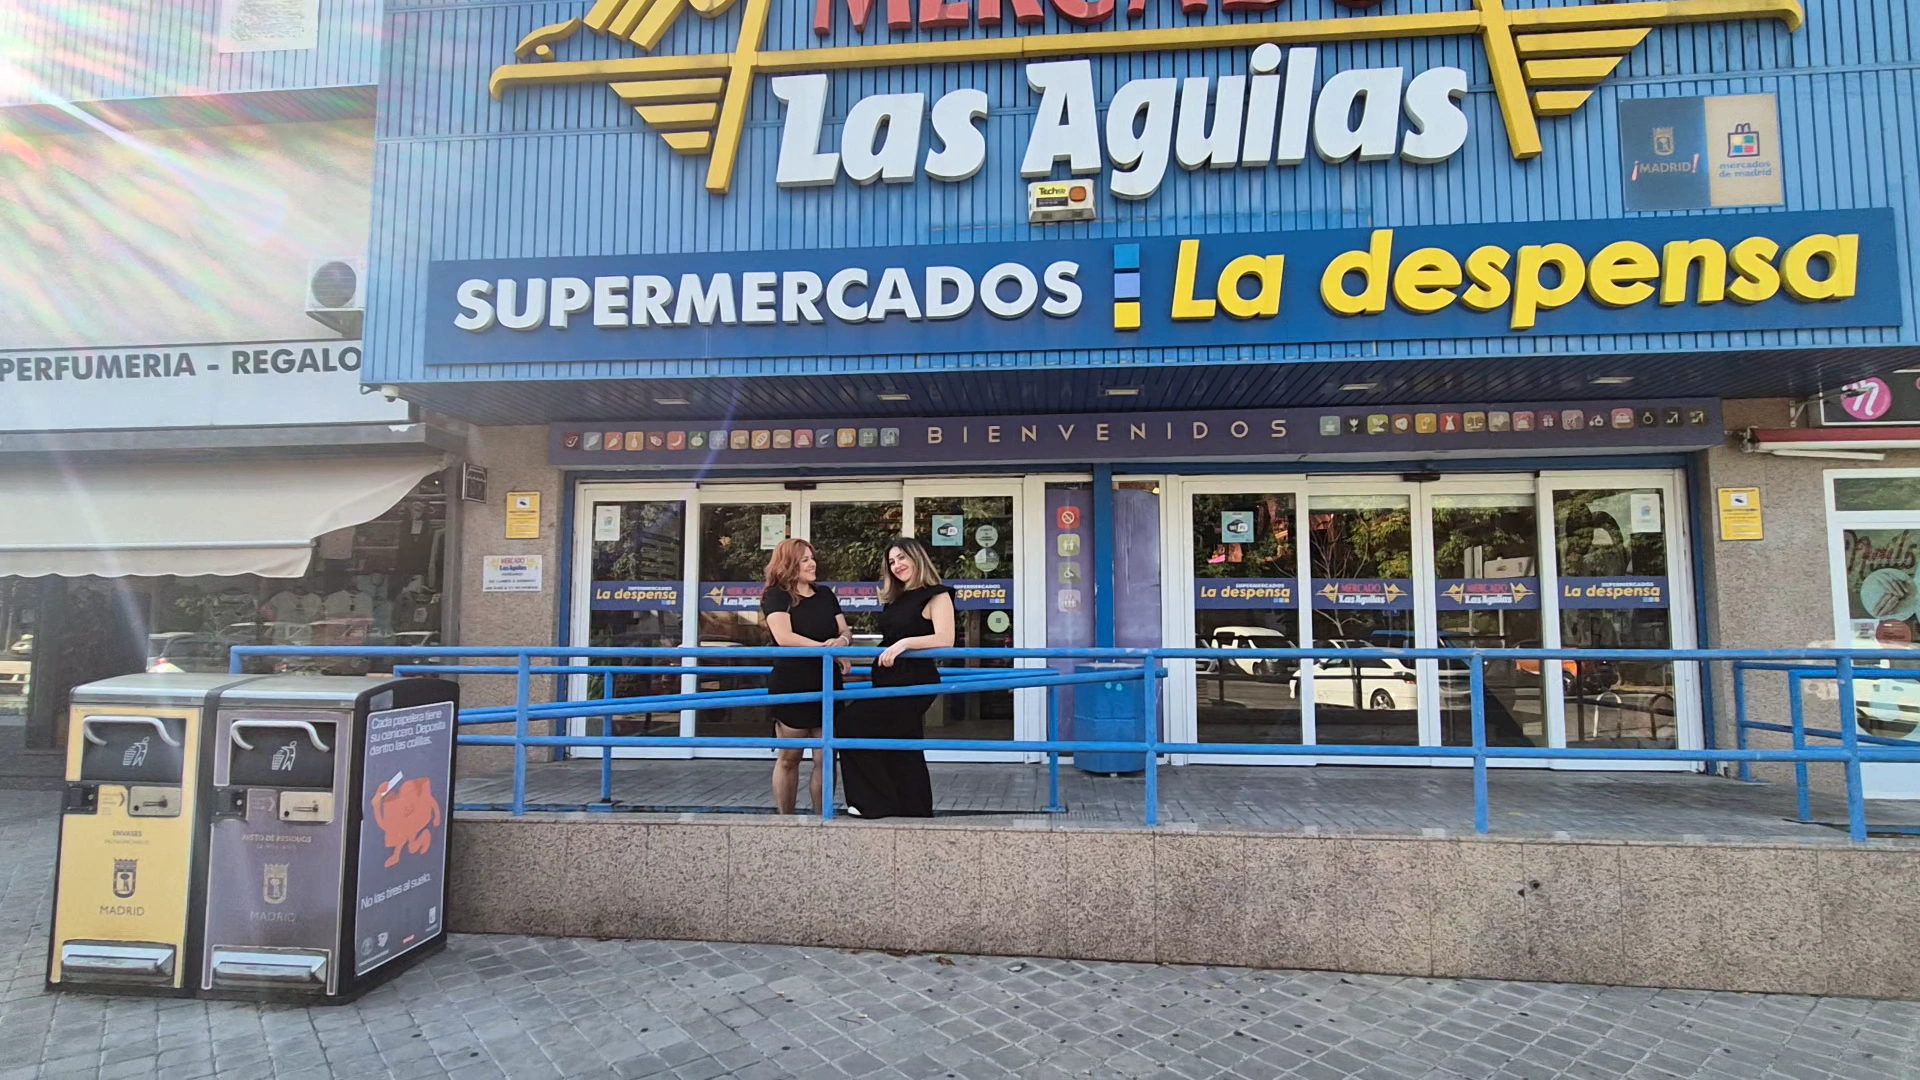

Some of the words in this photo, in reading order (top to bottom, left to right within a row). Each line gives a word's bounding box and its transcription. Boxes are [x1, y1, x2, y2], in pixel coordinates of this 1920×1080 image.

[771, 73, 988, 188] Las
[1020, 43, 1470, 200] Aguilas
[1719, 160, 1772, 170] mercados
[1719, 169, 1733, 178] de
[1734, 168, 1772, 178] madrid
[454, 259, 1084, 332] SUPERMERCADOS
[1171, 239, 1286, 321] La
[1320, 228, 1860, 330] despensa
[0, 353, 197, 382] PERFUMERIA
[232, 346, 361, 375] REGALO
[927, 419, 1287, 444] BIENVENIDOS
[596, 588, 610, 600] La
[614, 588, 678, 601] despensa
[956, 588, 1006, 601] spensa
[1201, 586, 1217, 598] La
[1221, 586, 1291, 600] despensa
[1341, 583, 1381, 593] MERCADO
[1565, 585, 1582, 597] La
[1586, 585, 1661, 599] despensa
[371, 717, 393, 730] Cada
[425, 710, 442, 720] tiene
[370, 733, 380, 743] su
[415, 721, 446, 735] Deposita
[369, 743, 394, 756] dentro
[395, 740, 406, 750] las
[360, 896, 373, 909] No
[373, 891, 386, 904] las
[386, 885, 402, 899] tires
[403, 879, 411, 892] al
[99, 905, 145, 917] MADRID
[250, 911, 296, 922] MADRID
